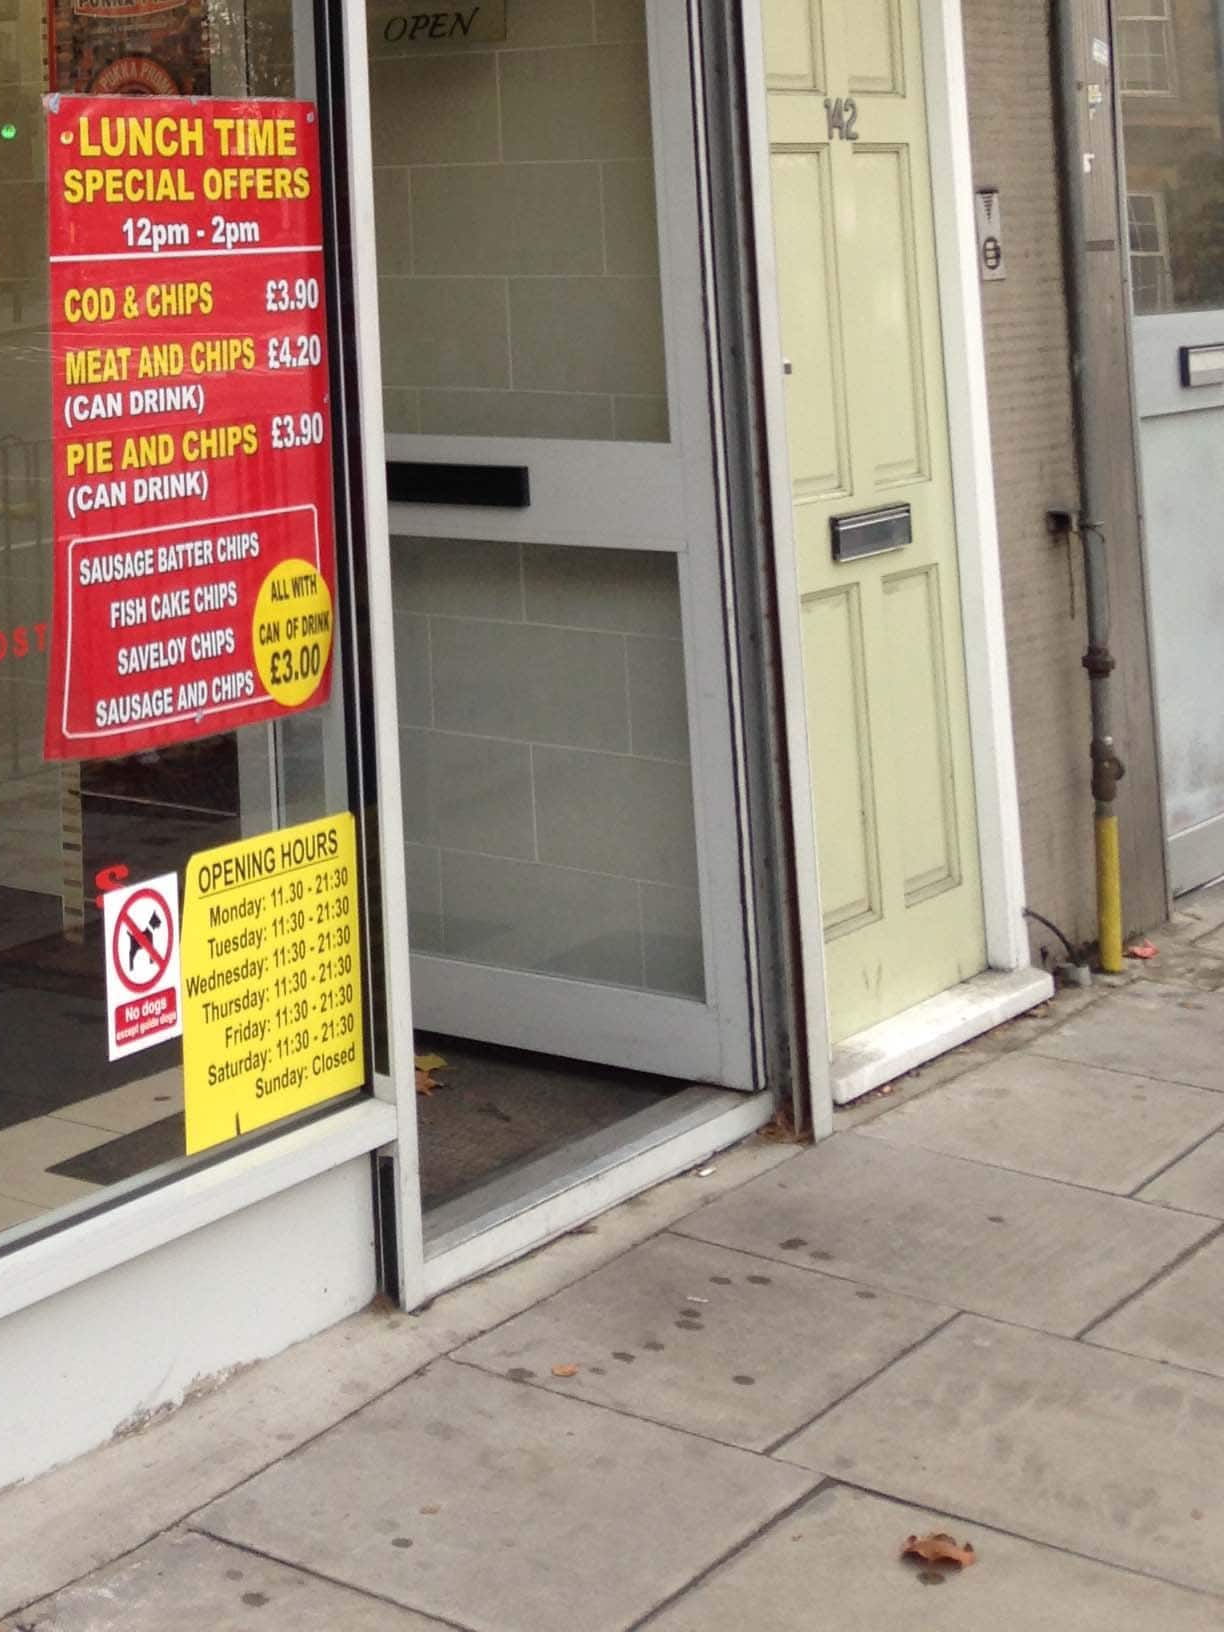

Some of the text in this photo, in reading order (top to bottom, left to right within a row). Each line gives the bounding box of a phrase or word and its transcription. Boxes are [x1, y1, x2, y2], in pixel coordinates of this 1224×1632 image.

[384, 7, 479, 42] OPEN
[79, 116, 297, 157] LUNCH TIME
[64, 168, 310, 203] SPECIAL OFFERS
[123, 217, 189, 252] 12pm
[211, 216, 259, 250] 2pm
[64, 282, 213, 322] COD & CHIPS
[265, 278, 319, 311] £3.90
[66, 337, 255, 385] MEAT AND CHIPS
[268, 335, 321, 368] £4.20
[64, 384, 204, 428] (CAN DRINK)
[67, 424, 258, 477] PIE AND CHIPS
[272, 412, 323, 449] £3.90
[68, 470, 208, 518] (CAN DRINK)
[80, 532, 260, 586] SAUSAGE BATTER CHIPS
[111, 581, 237, 629] FISH CAKE CHIPS
[271, 573, 317, 603] ALL WITH
[118, 628, 235, 676] SAVELOY CHIPS
[259, 610, 330, 646] CAN OF DRINK
[270, 643, 321, 686] £3.00
[96, 670, 254, 728] SAUSAGE AND CHIPS
[198, 829, 338, 894] OPENING HOURS
[209, 894, 266, 929] Monday:
[315, 866, 348, 894] 21:30
[208, 925, 267, 960] Tuesday:
[271, 909, 305, 936] 11:30
[316, 895, 350, 923] 21:30
[186, 958, 268, 999] Wednesday:
[273, 939, 306, 967] 11:30
[317, 925, 351, 953] 21:30
[125, 997, 167, 1023] No dogs
[202, 988, 269, 1025] Thursday:
[274, 969, 308, 997] 11:30
[319, 954, 352, 982] 21:30
[225, 1015, 271, 1049] Friday:
[275, 999, 309, 1027] 11:30
[320, 984, 353, 1012] 21:30
[207, 1048, 272, 1087] Saturday:
[276, 1029, 310, 1059] 11:30
[321, 1014, 354, 1043] 21:30
[255, 1042, 356, 1099] Sunday: Closed
